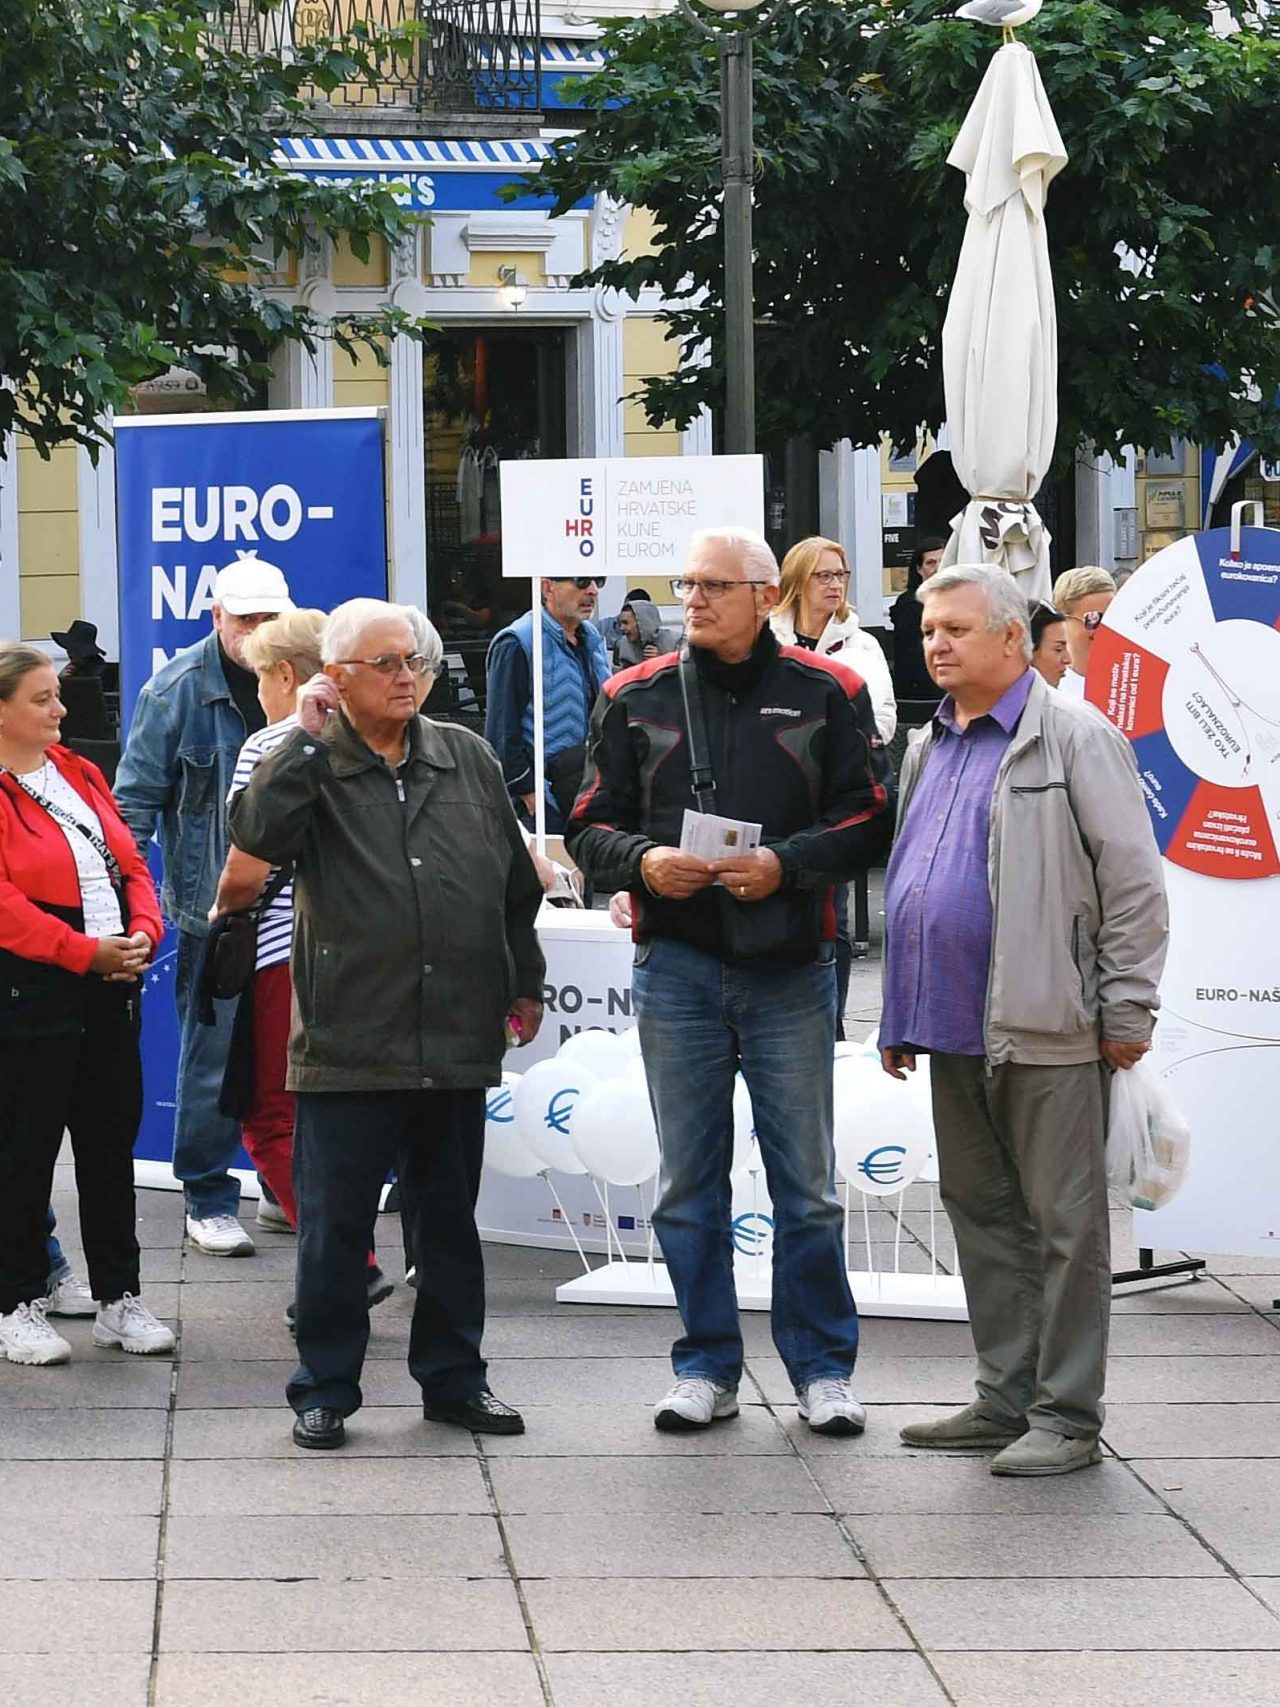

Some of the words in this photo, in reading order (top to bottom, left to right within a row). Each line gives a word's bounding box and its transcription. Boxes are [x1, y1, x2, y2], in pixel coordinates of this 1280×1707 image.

[618, 480, 693, 496] ZAMJENA
[151, 484, 334, 543] EURO-
[617, 500, 697, 516] HRVATSKE
[617, 521, 660, 537] KUNE
[884, 533, 900, 543] FIVE
[617, 542, 674, 558] EUROM
[1111, 662, 1120, 687] motiv
[1132, 653, 1141, 678] eura?
[1185, 701, 1201, 719] BITI
[1192, 691, 1241, 754] EUROZNALAC?
[1214, 739, 1228, 759] TKO
